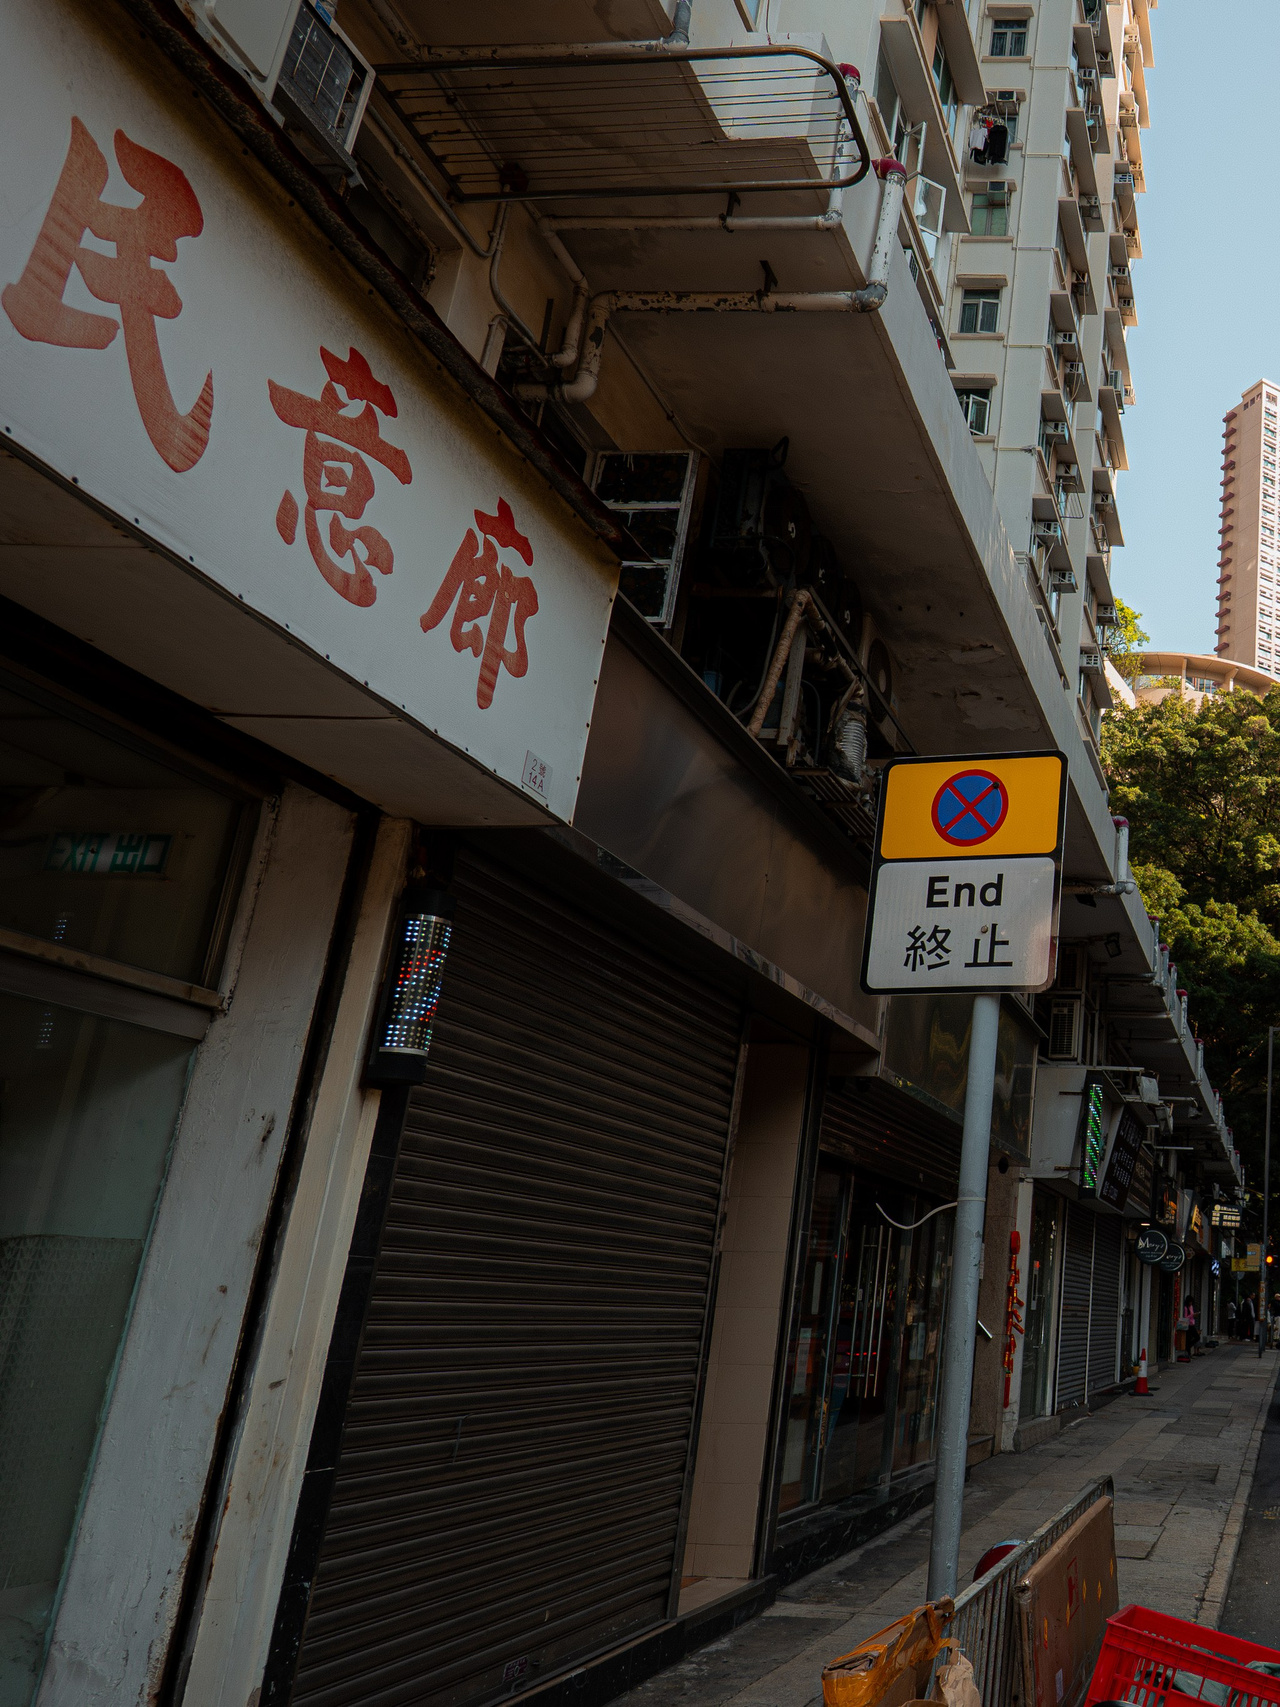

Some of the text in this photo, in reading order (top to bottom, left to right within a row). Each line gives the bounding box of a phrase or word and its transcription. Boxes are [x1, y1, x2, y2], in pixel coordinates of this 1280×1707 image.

[3, 116, 540, 710] 民意廊
[43, 832, 174, 873] EXIT 出口
[926, 873, 1004, 908] End
[903, 923, 1013, 972] 終止
